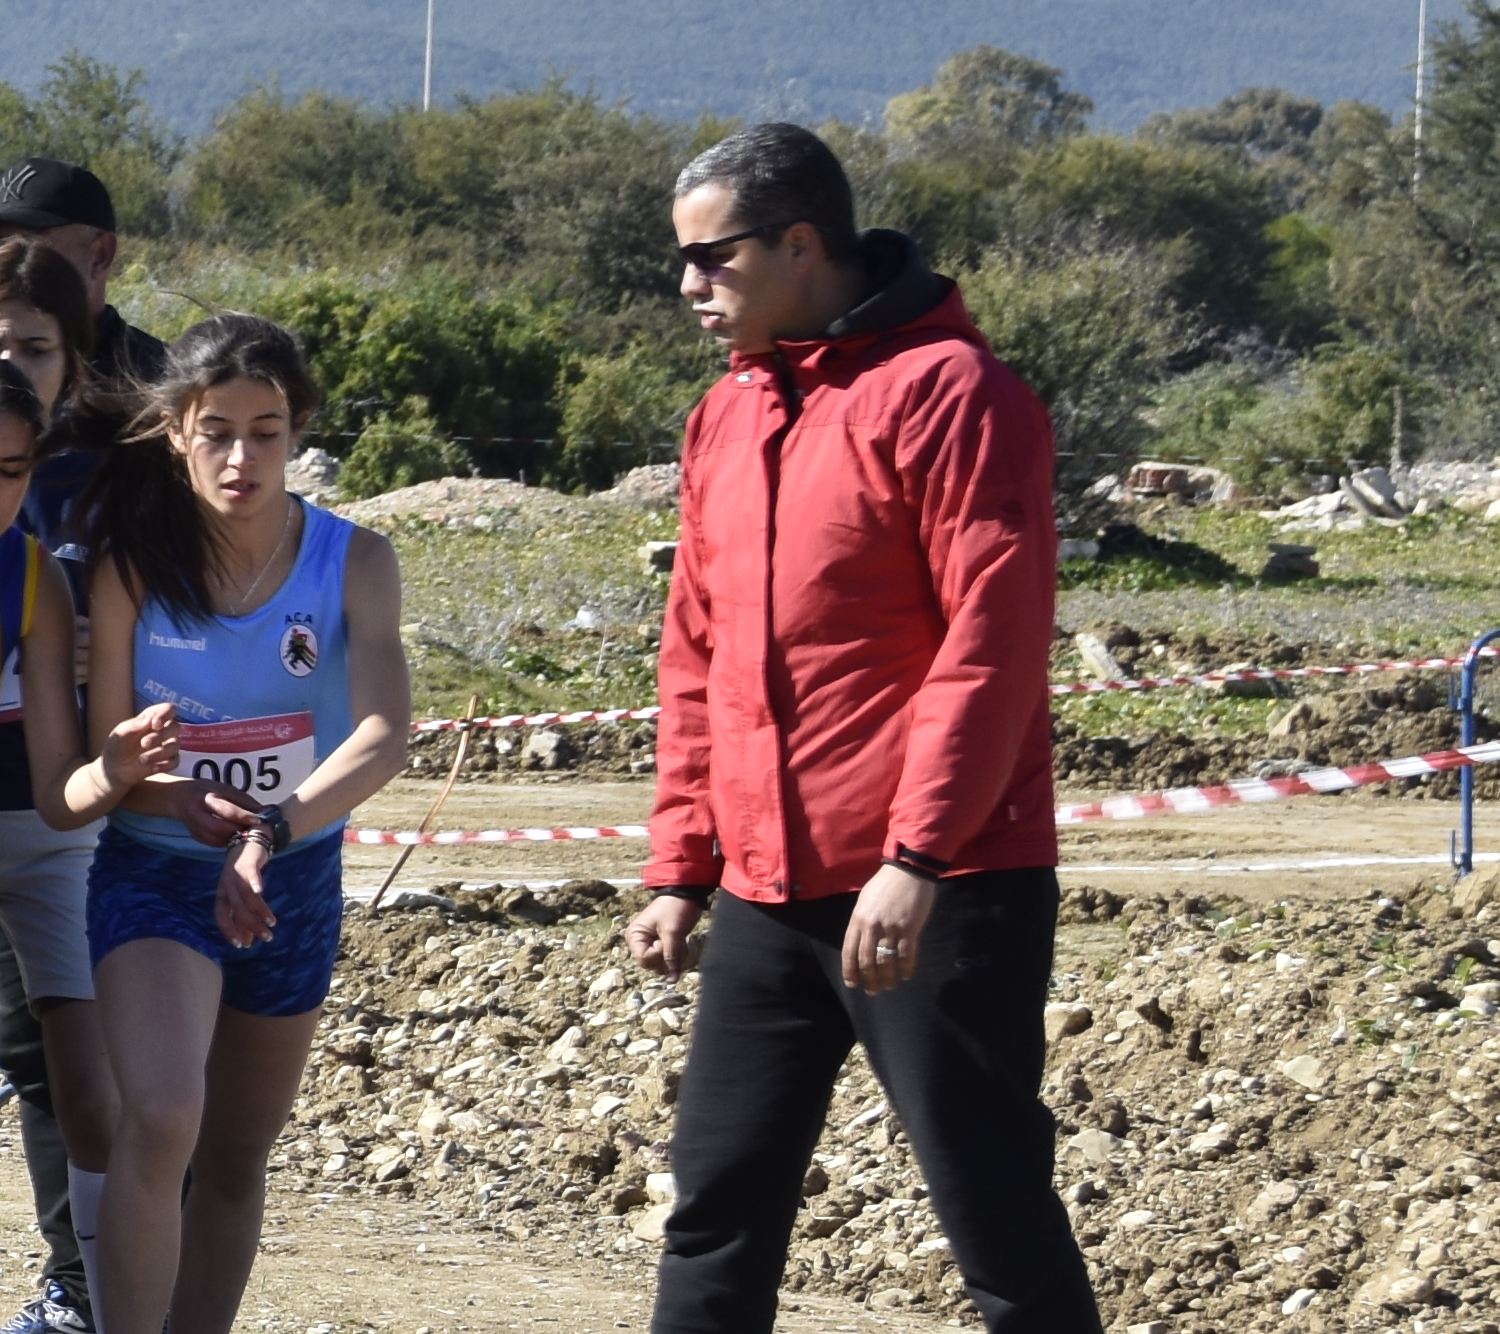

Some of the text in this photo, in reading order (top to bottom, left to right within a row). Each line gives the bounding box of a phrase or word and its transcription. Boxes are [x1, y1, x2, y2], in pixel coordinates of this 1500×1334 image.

[284, 611, 313, 625] ACA
[143, 679, 215, 722] ATHLETIC
[192, 754, 281, 792] 005
